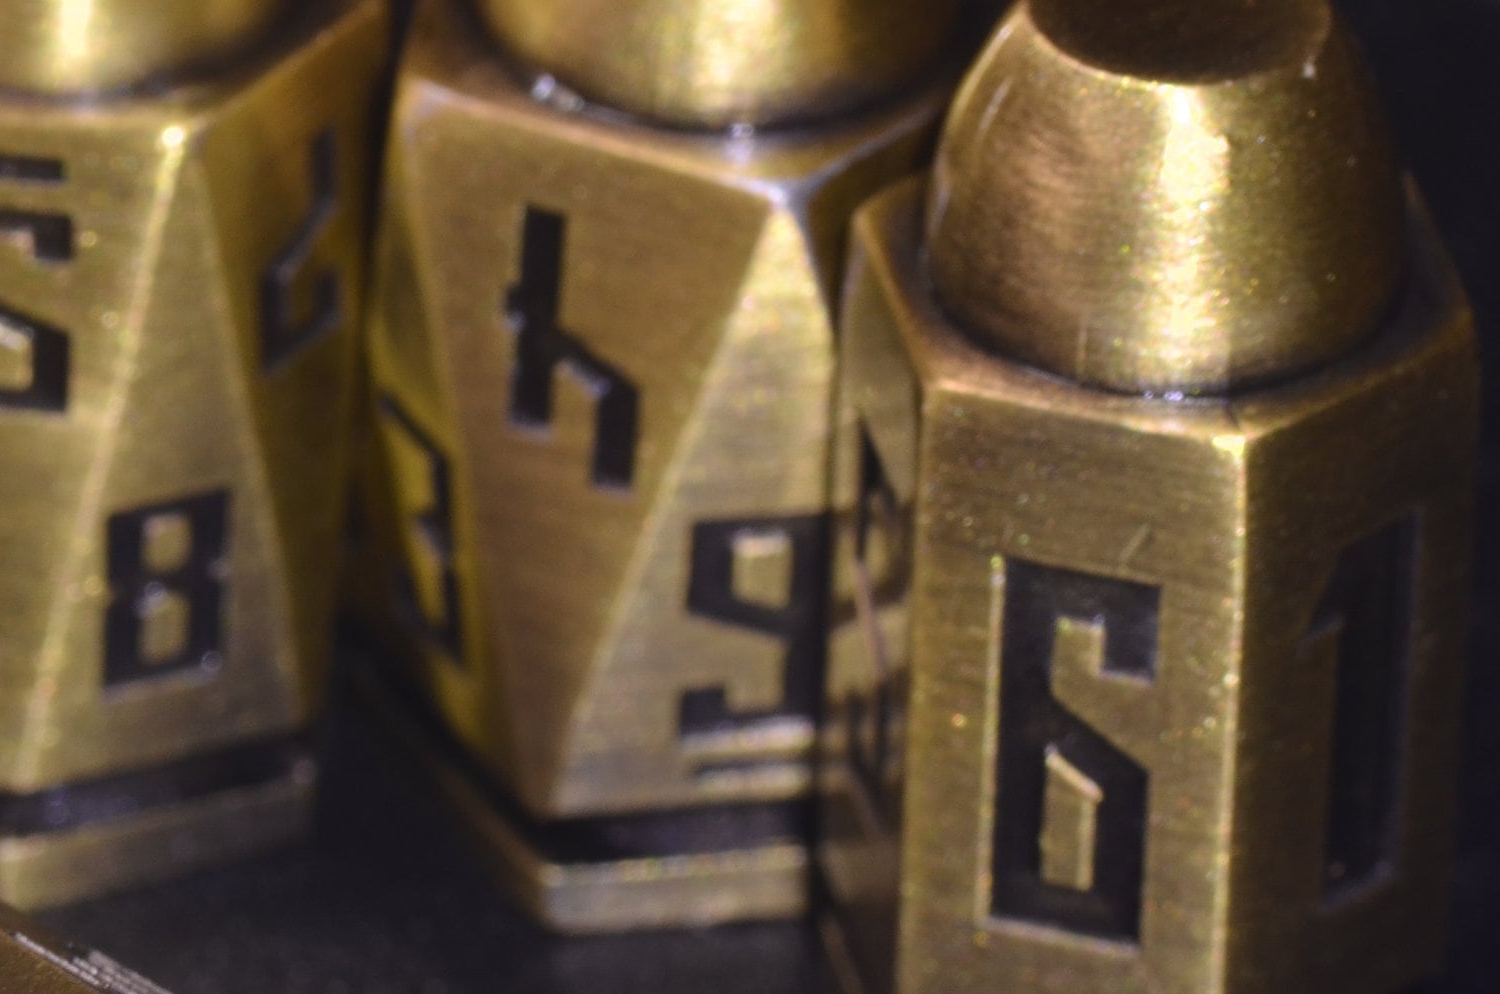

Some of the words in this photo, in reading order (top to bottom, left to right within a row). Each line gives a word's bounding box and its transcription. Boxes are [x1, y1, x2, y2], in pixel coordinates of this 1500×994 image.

[105, 488, 233, 690] 8
[978, 553, 1162, 952] 6
[1300, 505, 1422, 912] 1
